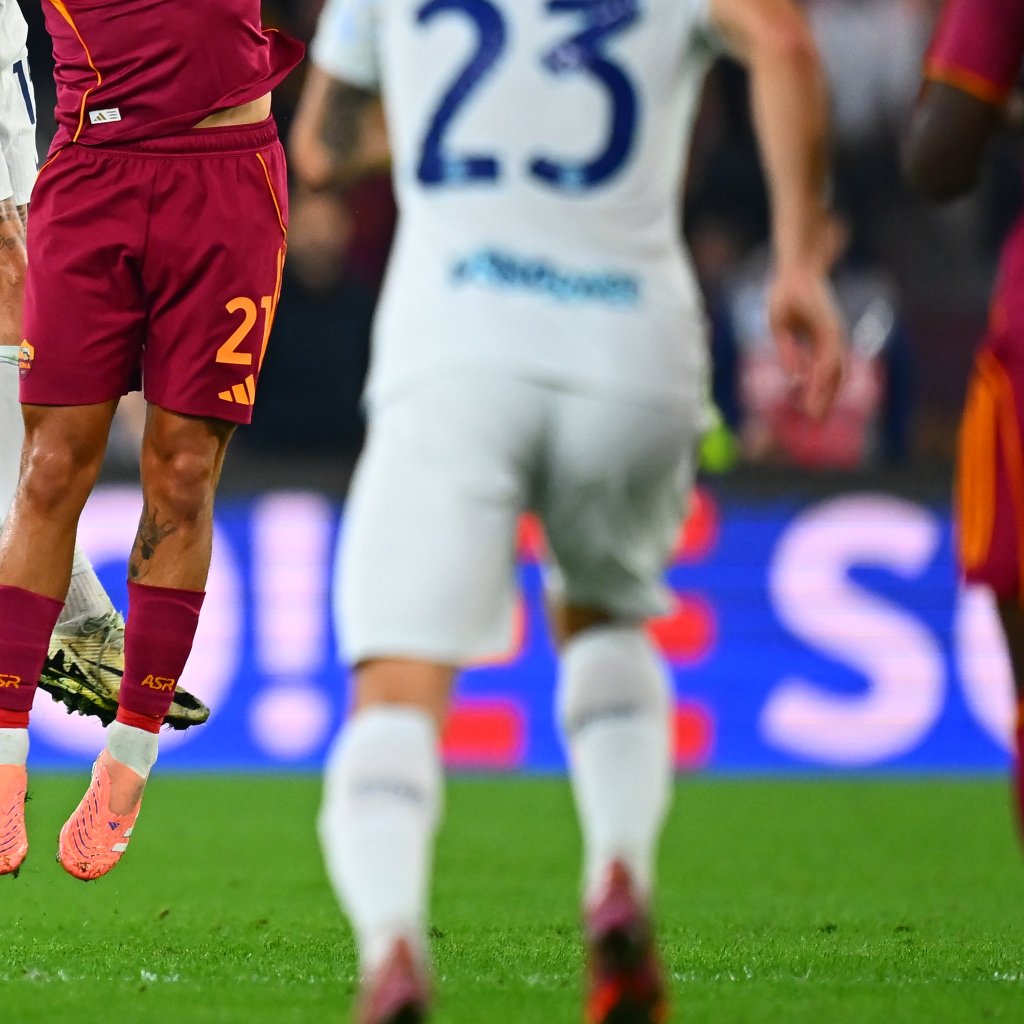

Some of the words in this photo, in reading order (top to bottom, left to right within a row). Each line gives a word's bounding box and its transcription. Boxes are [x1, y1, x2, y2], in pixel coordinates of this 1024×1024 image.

[216, 296, 272, 373] 21
[759, 492, 1014, 766] S
[141, 674, 176, 692] ASR
